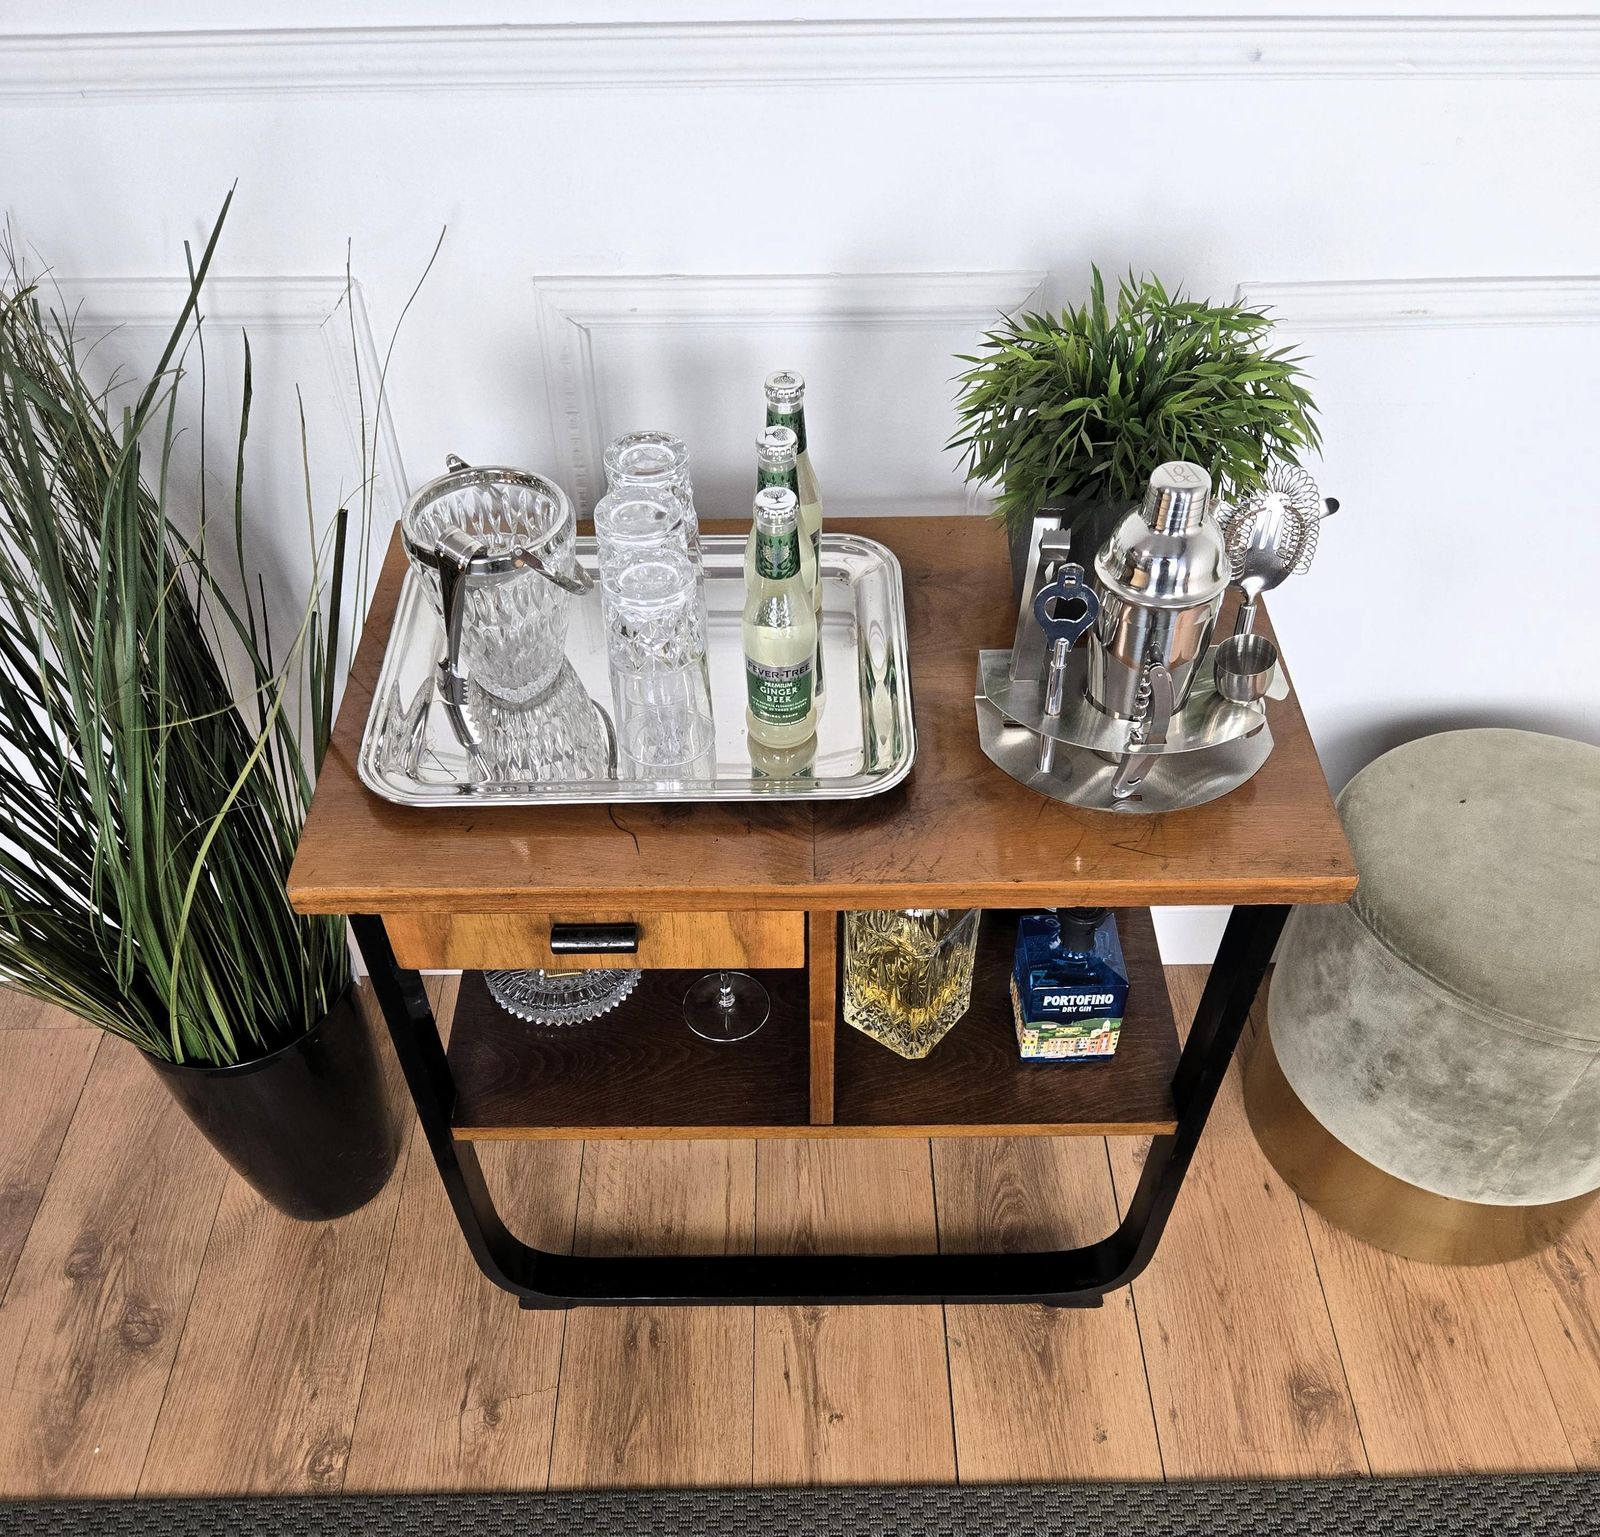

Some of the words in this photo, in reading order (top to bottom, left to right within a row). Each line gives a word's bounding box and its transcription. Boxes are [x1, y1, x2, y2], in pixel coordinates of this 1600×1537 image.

[747, 660, 810, 679] FEVER-TREE
[760, 687, 798, 696] GINGER
[766, 695, 792, 703] BEER
[1043, 994, 1114, 1007] PORTOFINO
